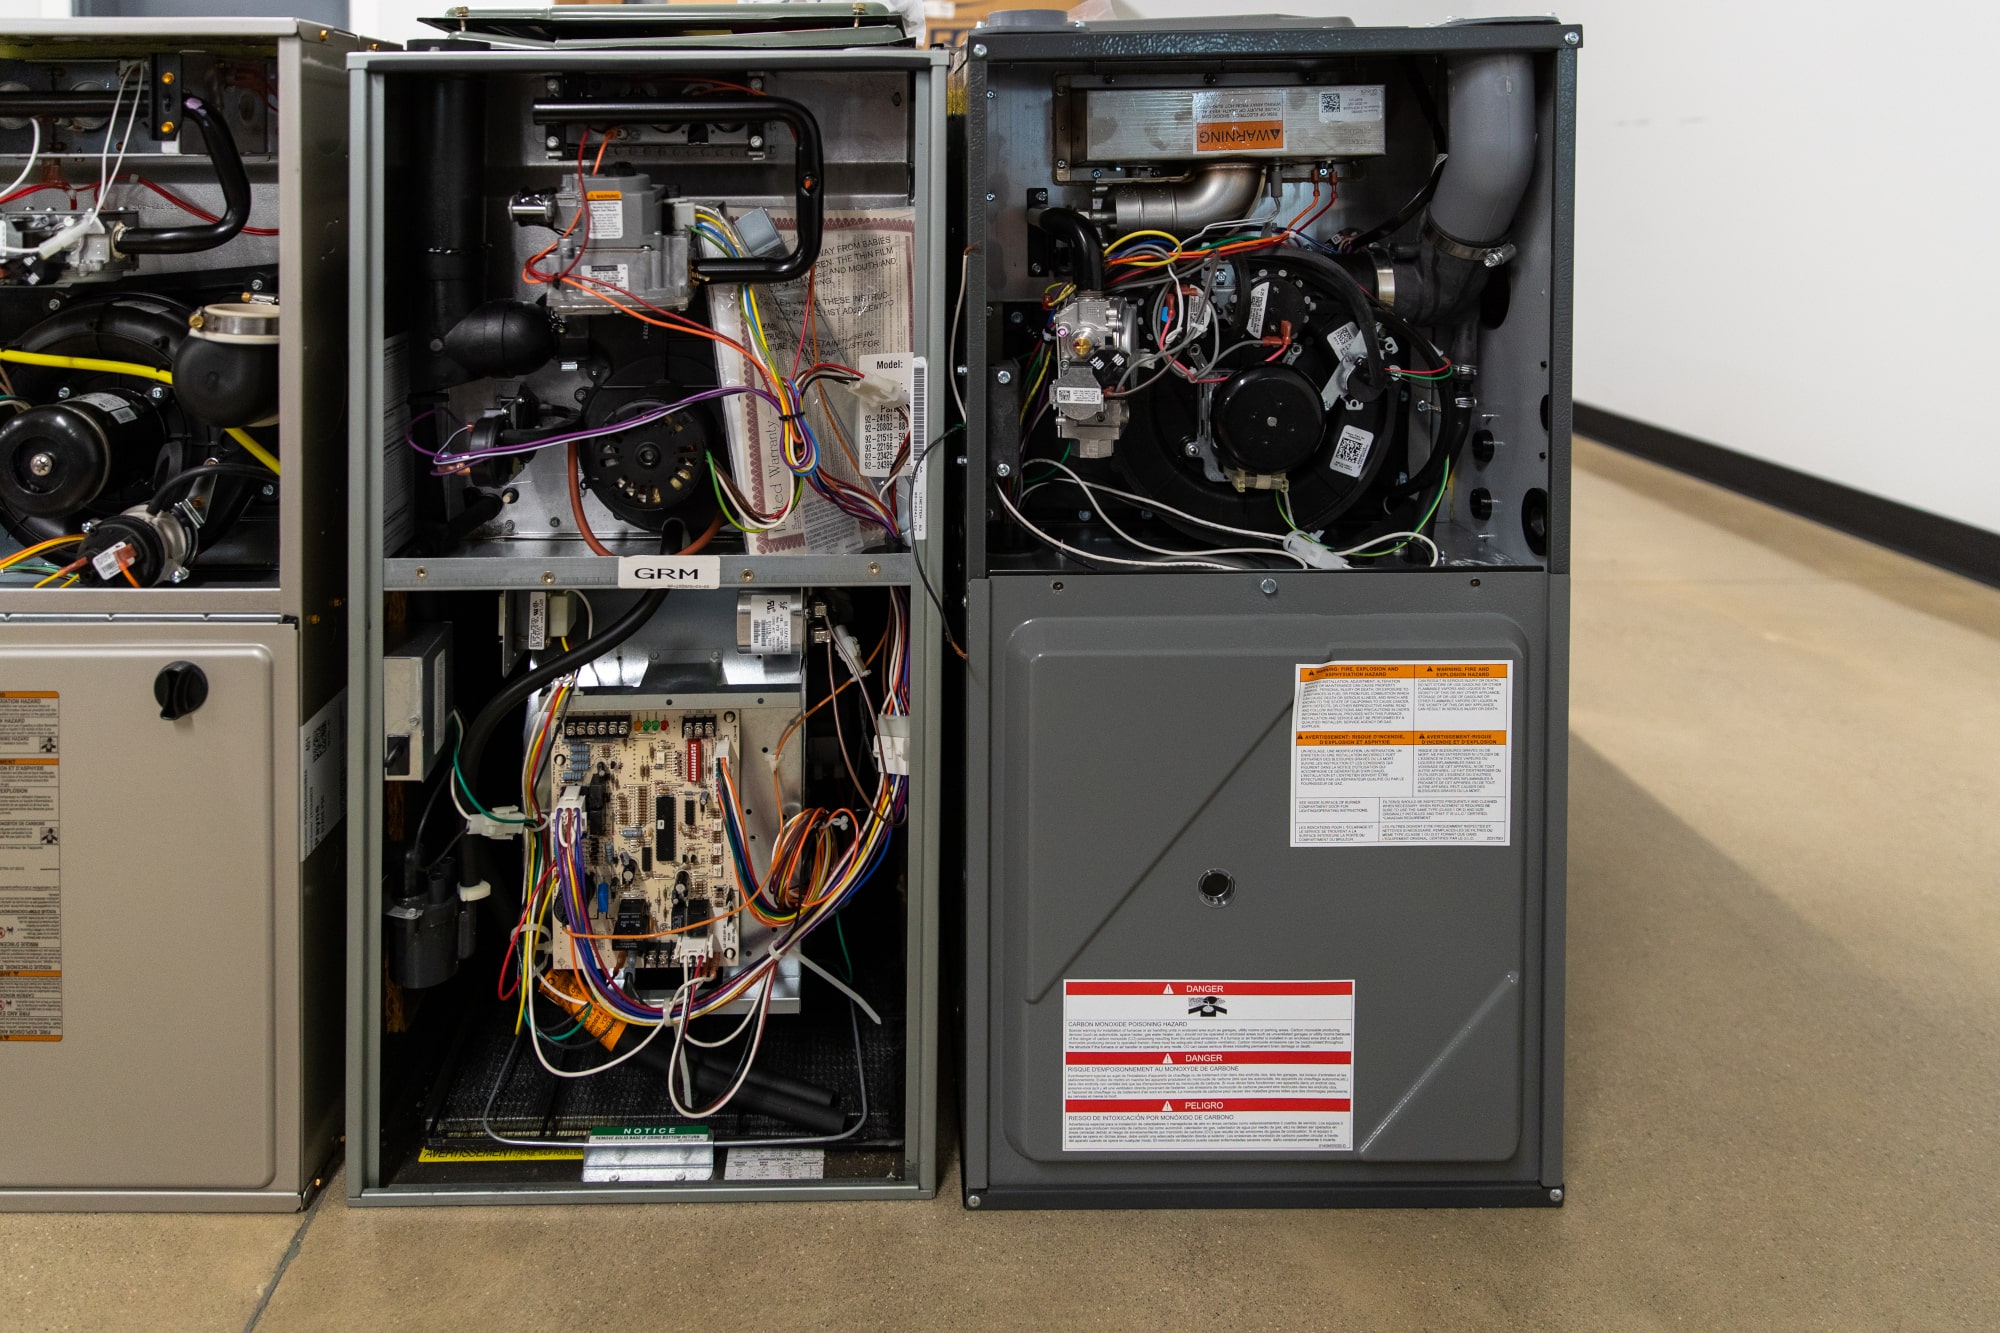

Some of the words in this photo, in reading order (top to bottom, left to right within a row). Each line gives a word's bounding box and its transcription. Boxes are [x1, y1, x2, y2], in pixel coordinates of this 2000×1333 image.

[1200, 129, 1270, 144] WARNING
[838, 242, 861, 254] FROM
[863, 236, 892, 248] BABIES
[838, 254, 853, 263] THE
[854, 250, 874, 260] THIN
[876, 247, 894, 257] FILM
[848, 262, 878, 273] MOUTH
[824, 295, 850, 306] THESE
[876, 360, 904, 370] Model:
[1089, 356, 1105, 370] OFF
[1112, 353, 1125, 366] ON
[634, 567, 699, 580] GRM
[1186, 985, 1224, 993] DANGER
[1185, 1054, 1223, 1062] DANGER
[1185, 1102, 1224, 1110] PELIGRO
